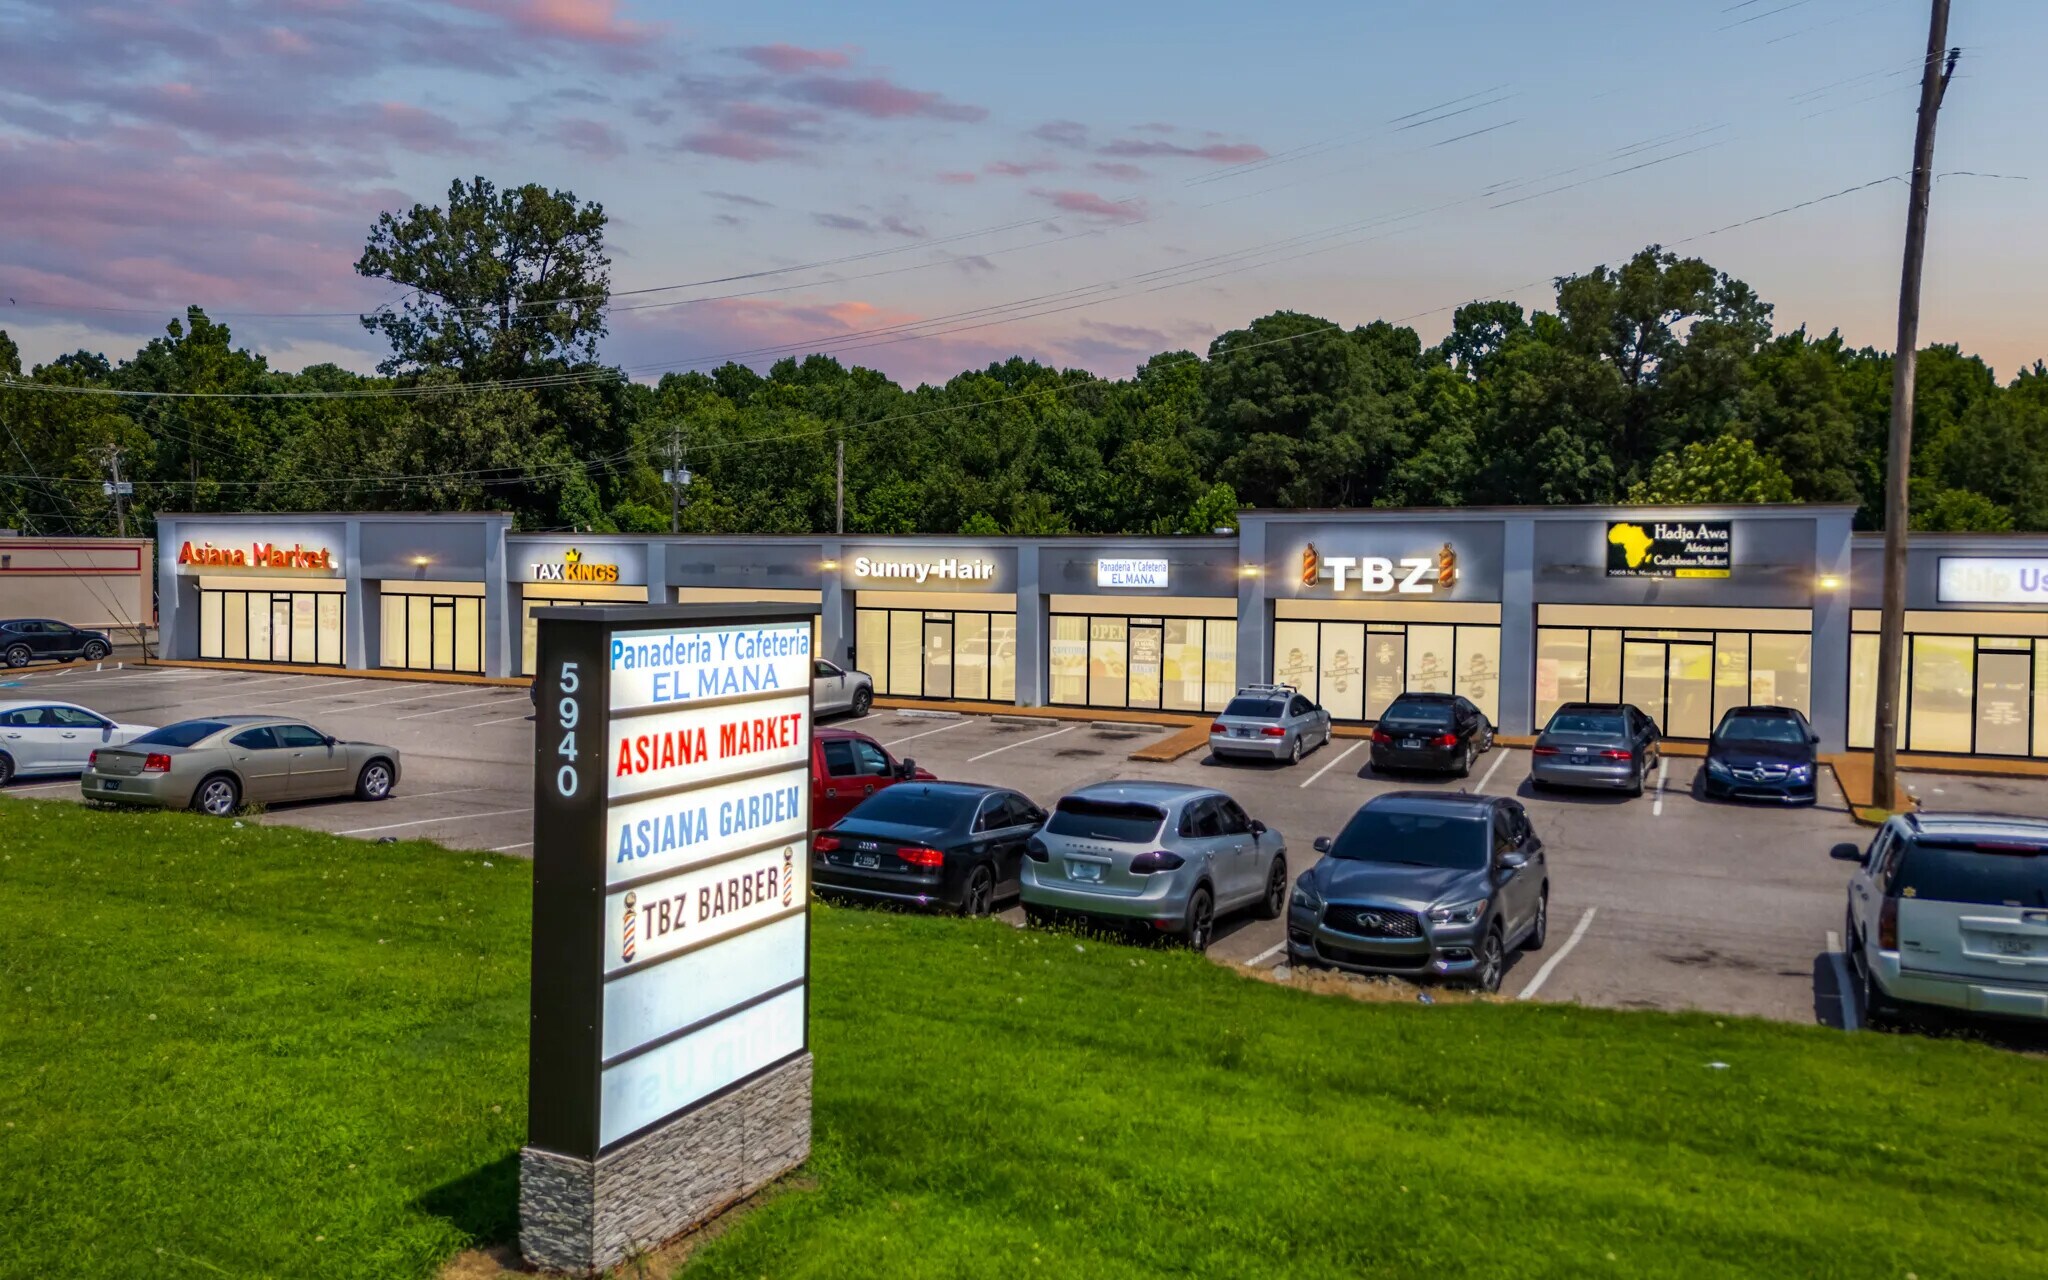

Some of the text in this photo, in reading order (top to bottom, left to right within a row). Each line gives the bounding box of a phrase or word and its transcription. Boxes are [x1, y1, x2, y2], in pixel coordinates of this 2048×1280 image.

[1654, 524, 1728, 542] Hadja Awa
[178, 541, 331, 568] Asiana Market
[854, 556, 995, 584] Sunny-Hair
[1100, 561, 1167, 572] Panaderia Y Cafeteria
[1697, 555, 1728, 565] Market
[531, 563, 619, 582] TAX KINGS
[1111, 573, 1155, 584] EL MANA
[1323, 557, 1434, 593] TBZ
[611, 629, 809, 671] Panaderia Y Cafeteria
[653, 663, 779, 703] EL MANA
[557, 662, 579, 797] 5940
[616, 713, 801, 777] ASIANA MARKET
[617, 786, 799, 864] ASIANA GARDEN
[642, 866, 779, 941] TBZ BARBER
